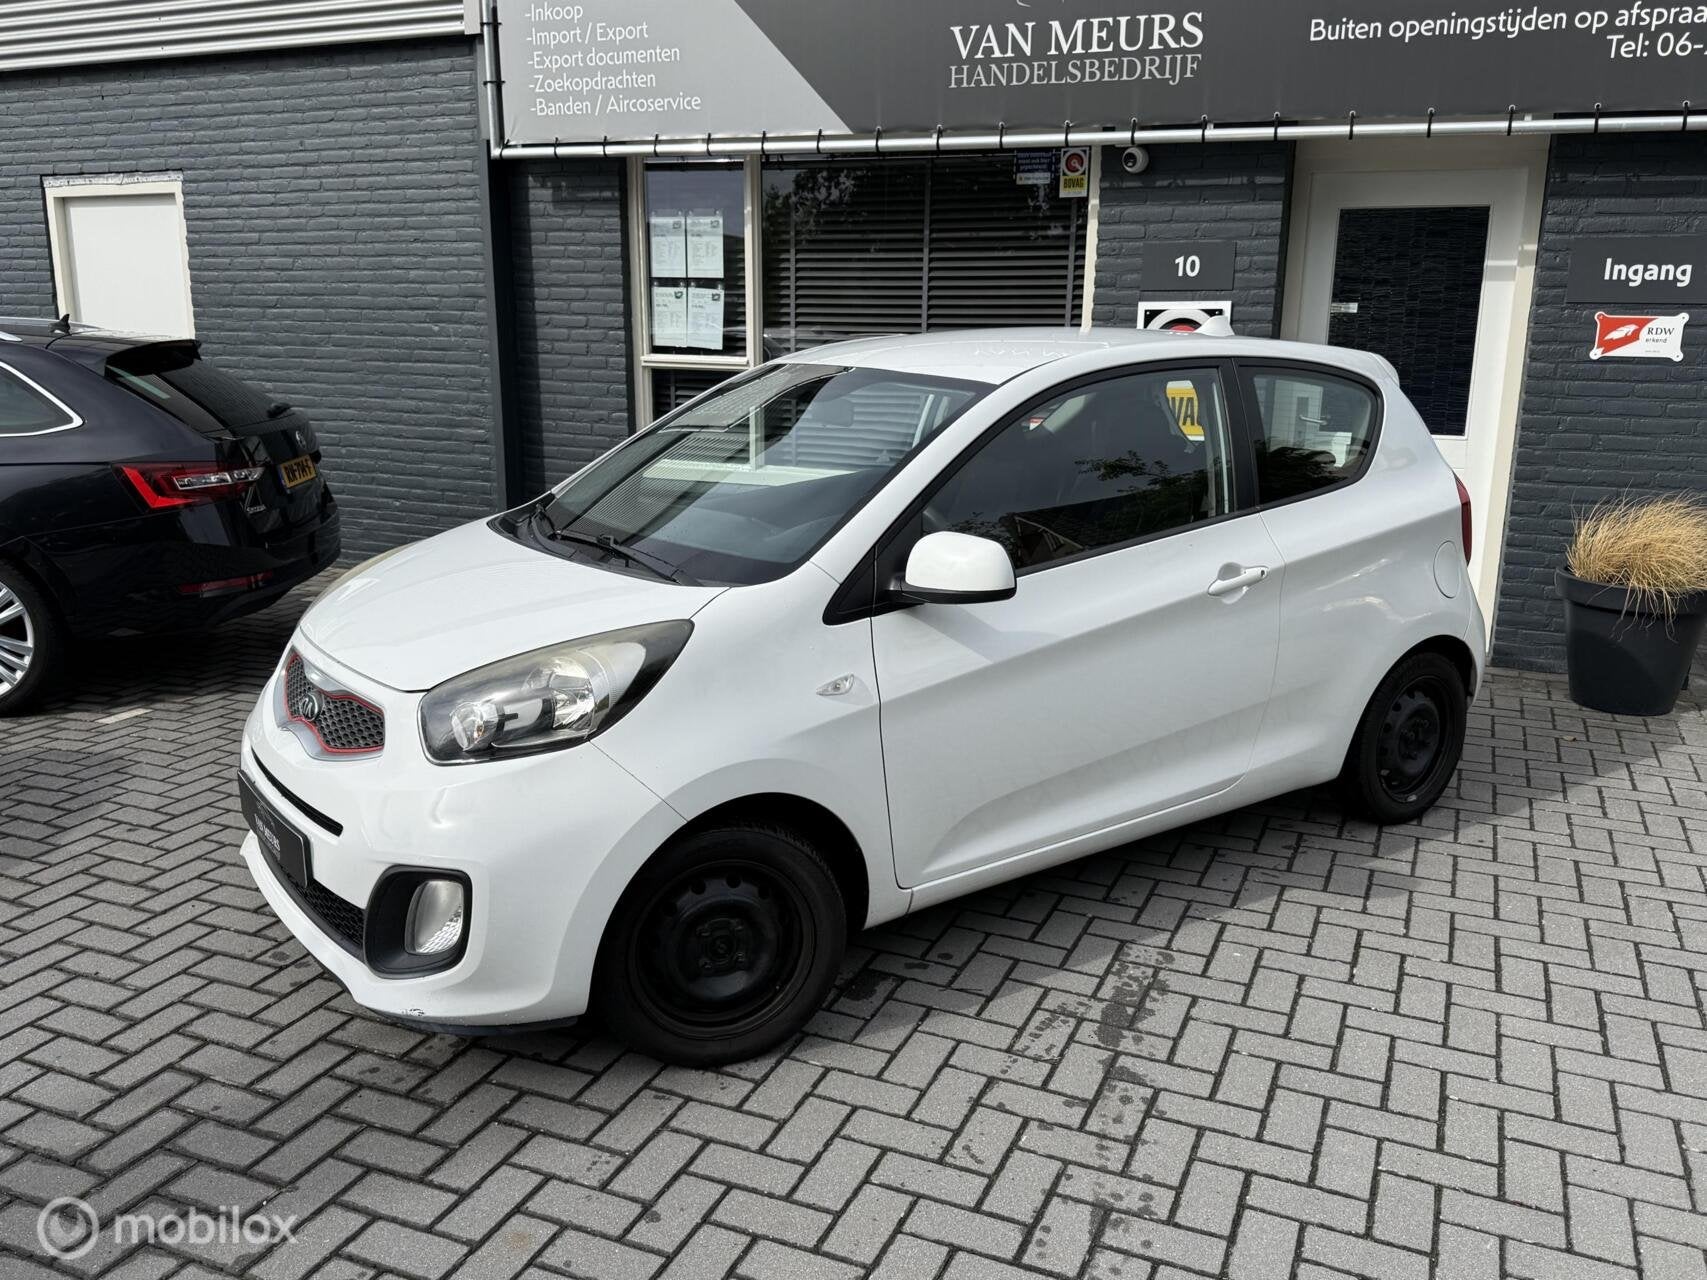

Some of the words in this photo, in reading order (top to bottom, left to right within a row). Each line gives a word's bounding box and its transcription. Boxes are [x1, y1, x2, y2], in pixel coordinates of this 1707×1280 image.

[525, 2, 583, 23] -Inkoop
[1309, 17, 1381, 41] Buiten
[1388, 7, 1567, 42] openingstijden
[1574, 11, 1608, 34] op
[526, 26, 582, 49] -Import
[585, 22, 592, 44] /
[597, 21, 648, 45] Export
[950, 22, 1036, 60] VAN
[1048, 12, 1204, 56] MEURS
[1606, 33, 1650, 59] Tel:
[1657, 32, 1707, 56] 06-
[528, 50, 584, 73] -Export
[586, 46, 680, 66] documenten
[949, 54, 1202, 88] HANDELSBEDRIJF
[528, 69, 656, 95] -Zoekopdrachten
[530, 96, 591, 116] -Banden
[594, 94, 602, 116] /
[606, 92, 701, 114] Aircoservice
[1174, 255, 1200, 277] 10
[1603, 258, 1692, 287] Ingang
[1647, 327, 1675, 335] RDW
